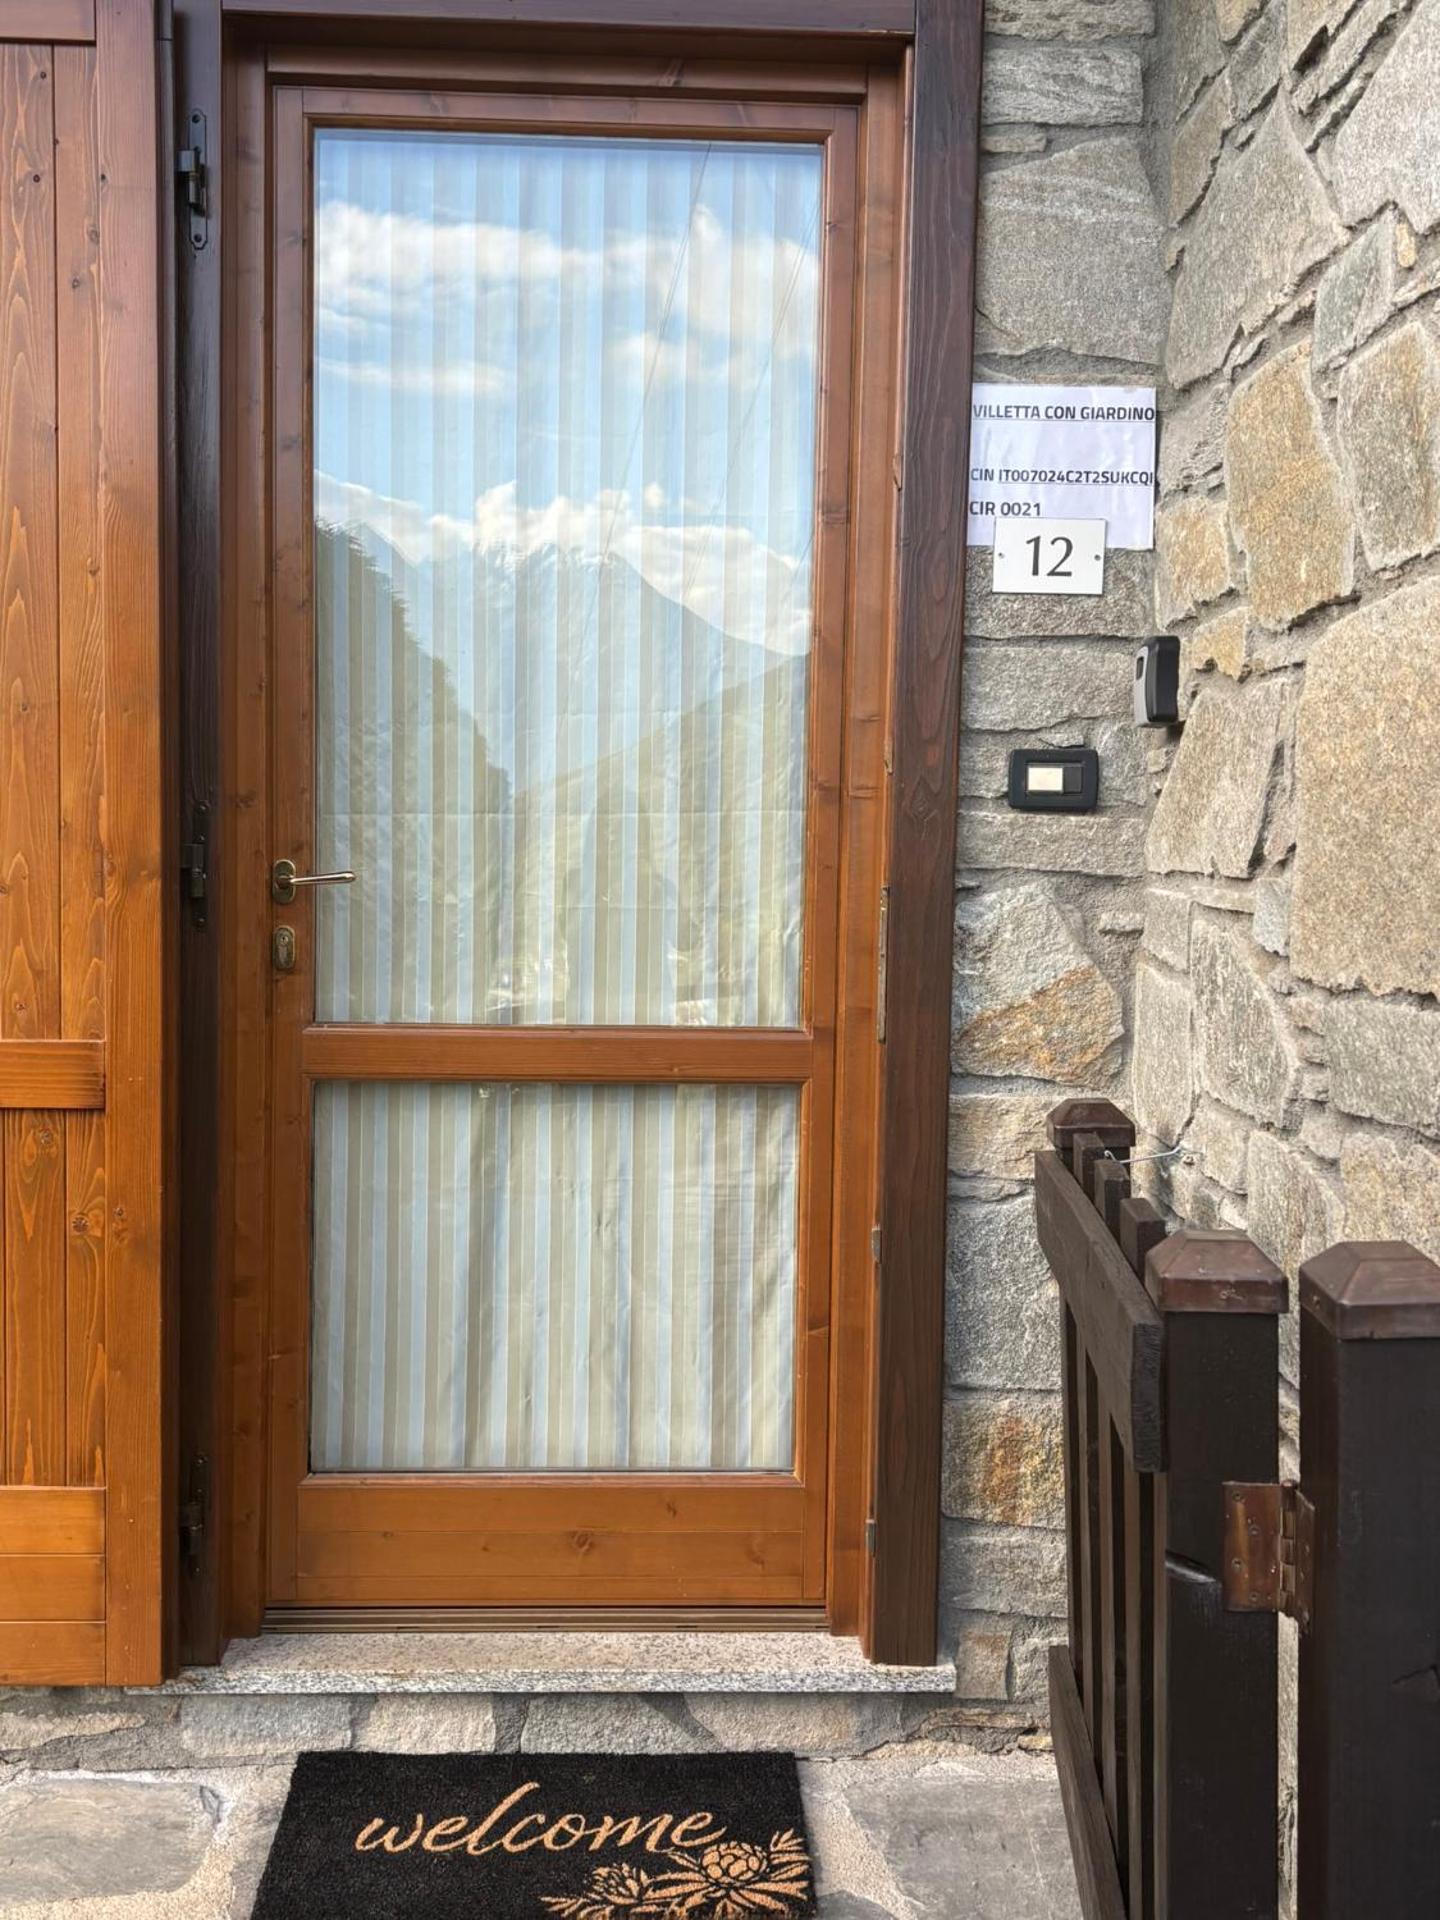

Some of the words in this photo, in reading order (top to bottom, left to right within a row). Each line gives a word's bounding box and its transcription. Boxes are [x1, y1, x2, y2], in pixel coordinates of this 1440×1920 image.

[973, 404, 1041, 419] VILLETTA
[1044, 405, 1076, 420] CON
[1080, 406, 1155, 421] GIARDINO
[970, 468, 995, 482] CIN
[969, 501, 996, 516] CIR
[1000, 502, 1042, 517] 0021
[1025, 535, 1074, 577] 12
[354, 1780, 727, 1855] welcome
